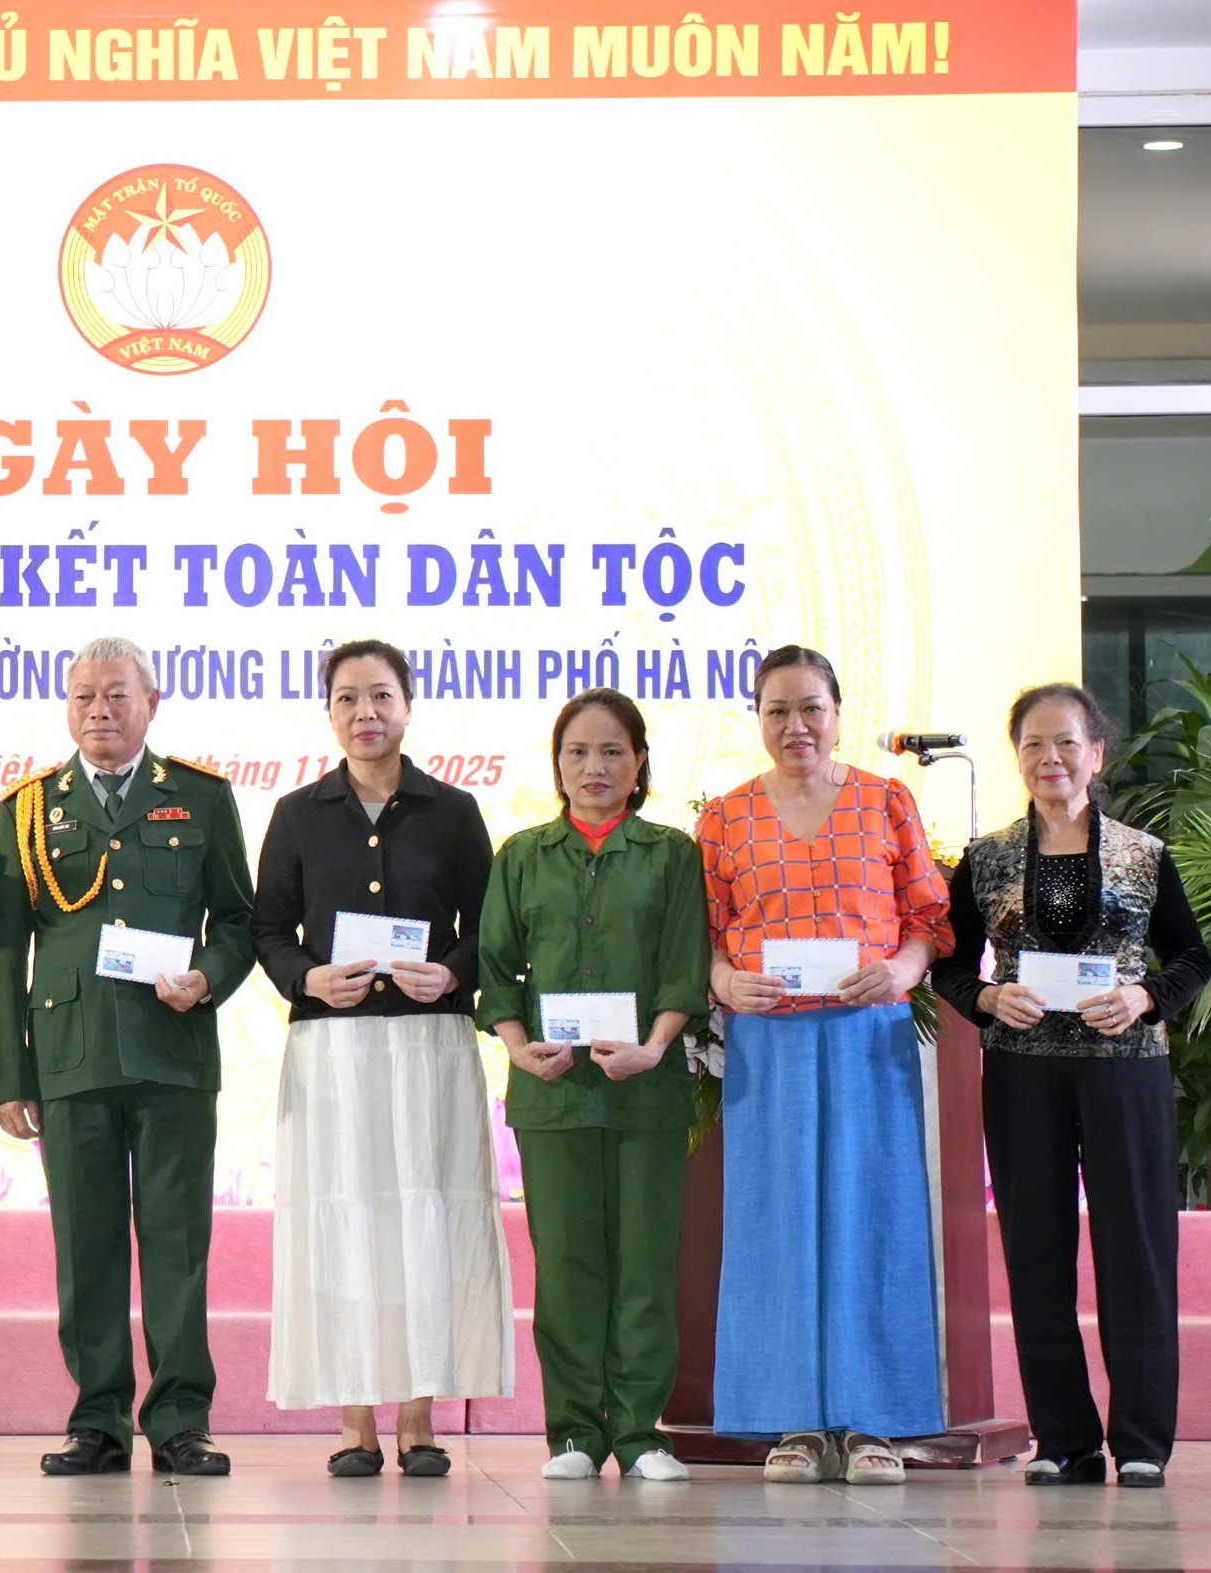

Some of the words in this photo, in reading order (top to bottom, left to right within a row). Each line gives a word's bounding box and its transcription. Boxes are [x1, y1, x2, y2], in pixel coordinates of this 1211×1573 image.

[49, 18, 239, 81] NGHĨA
[257, 16, 388, 92] VIỆT
[406, 26, 551, 80] NAM
[573, 13, 759, 79] MUÔN
[781, 12, 951, 77] NĂM!
[112, 177, 160, 203] TRẬN
[200, 187, 242, 223] QUỐC
[118, 336, 163, 359] VIỆT
[169, 337, 210, 360] NAM
[251, 399, 493, 515] HỘI
[0, 521, 148, 608] KẾT
[174, 528, 380, 608] TOÀN
[406, 529, 565, 608] DÂN
[592, 527, 746, 623] TỘC
[409, 638, 521, 699] HÀNH
[538, 631, 621, 699] PHỐ
[637, 639, 691, 699] HÀ
[707, 638, 775, 711] NỘ
[295, 755, 330, 787] 11
[427, 754, 506, 787] 2025
